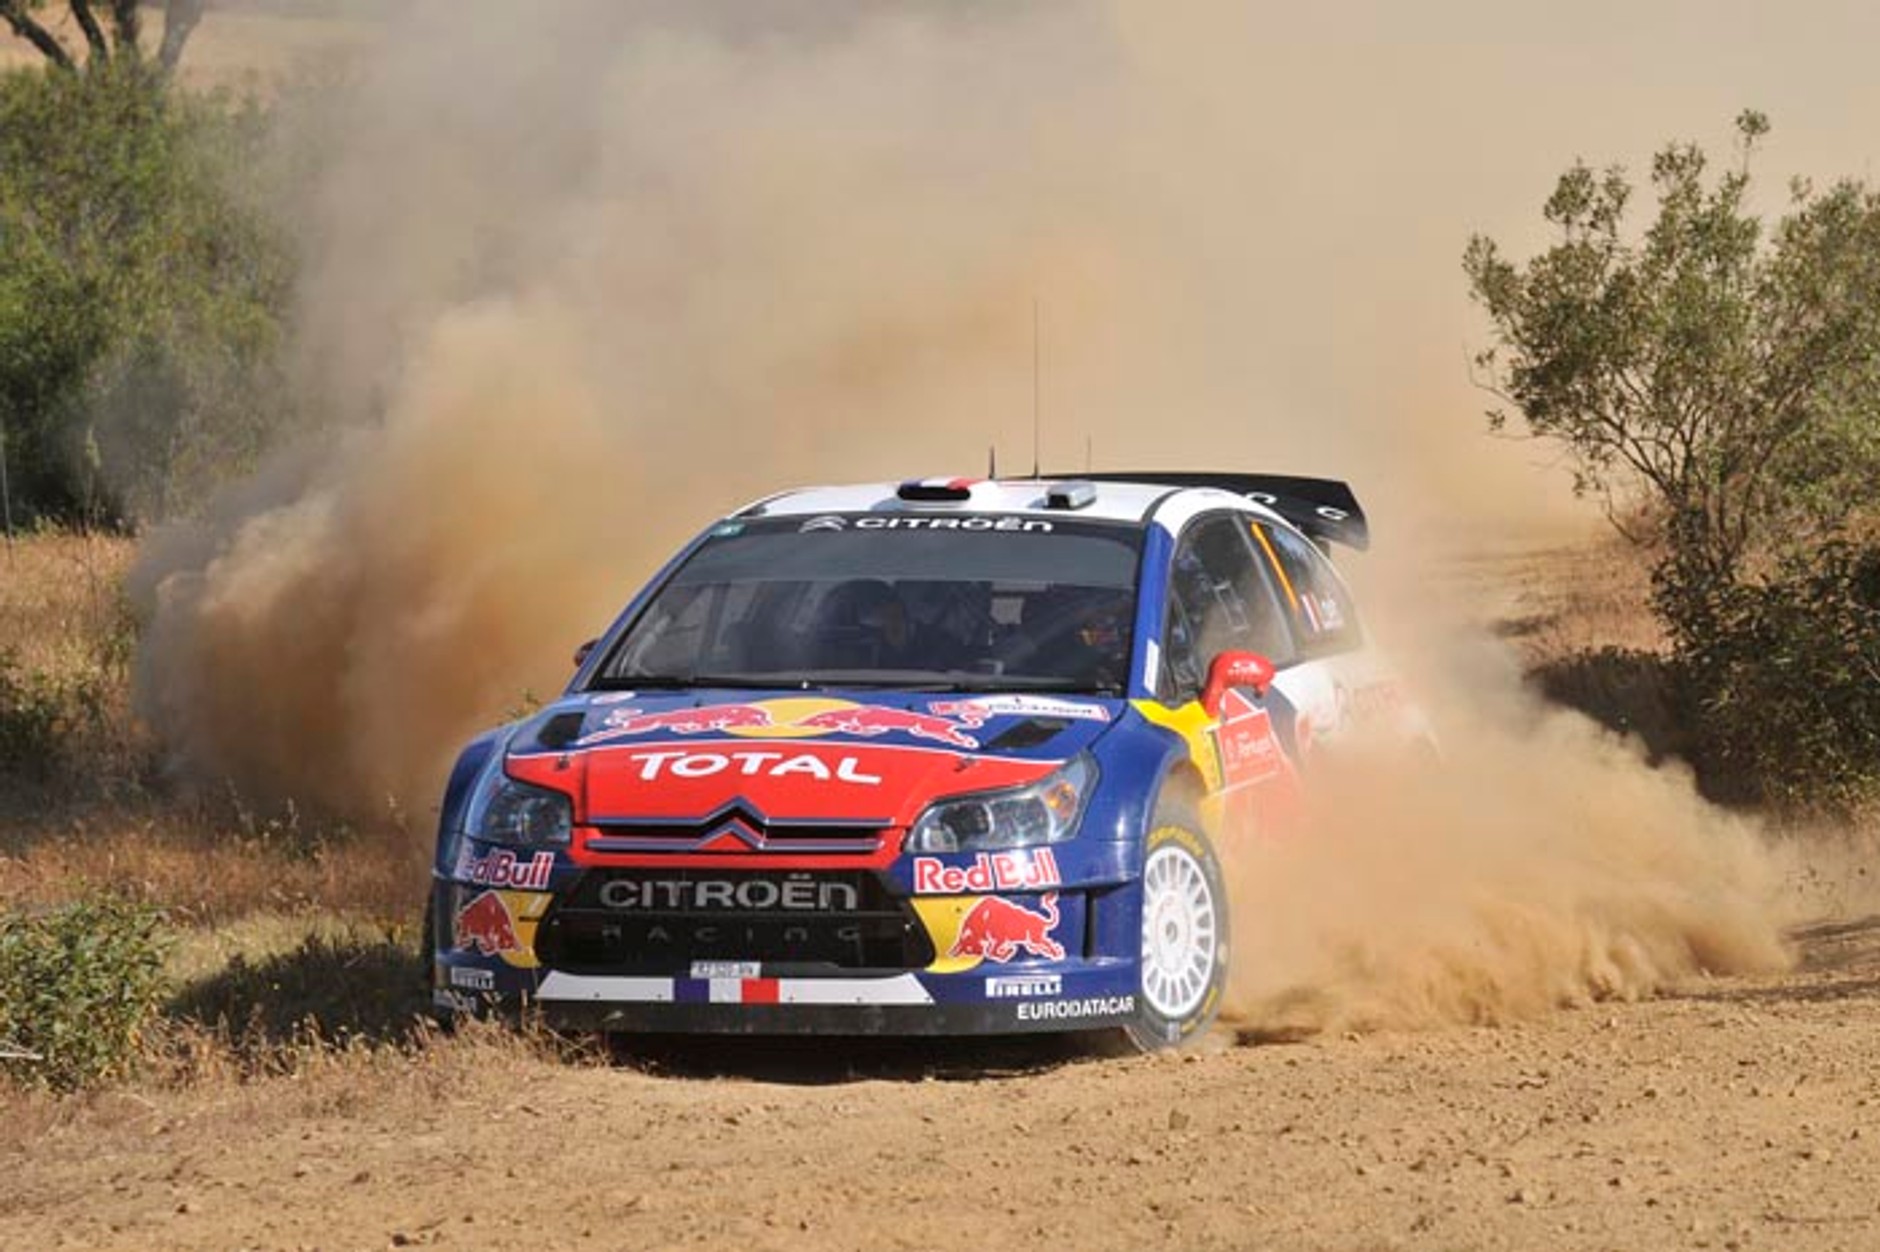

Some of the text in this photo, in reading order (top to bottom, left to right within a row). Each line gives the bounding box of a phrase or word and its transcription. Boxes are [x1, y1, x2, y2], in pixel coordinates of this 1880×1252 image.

[630, 751, 882, 785] TOTAL
[491, 851, 555, 890] Bull
[914, 847, 1061, 893] Red Bull
[985, 974, 1062, 998] PIRELLI
[1017, 996, 1135, 1020] EURODATACAR
